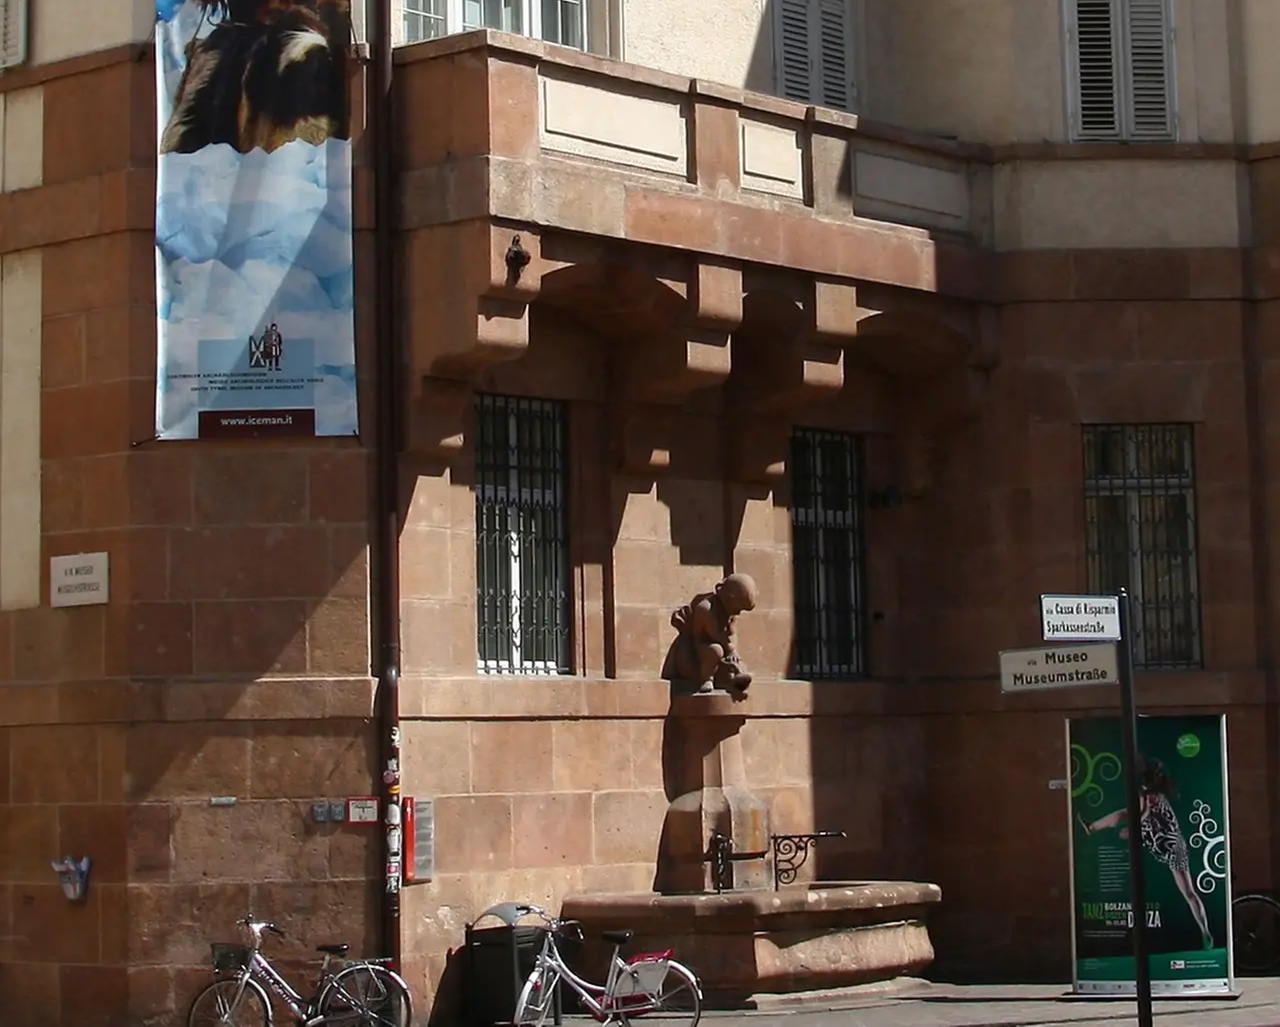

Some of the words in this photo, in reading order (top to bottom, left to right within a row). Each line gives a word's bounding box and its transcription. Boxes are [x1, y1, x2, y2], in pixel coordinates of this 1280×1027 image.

[220, 415, 293, 426] www.iceman.it
[1055, 602, 1074, 615] Cassa
[1076, 602, 1082, 615] di
[1084, 602, 1116, 617] Risparmio
[1045, 652, 1088, 665] Museo
[1013, 668, 1108, 686] Museumstraße
[1104, 902, 1132, 911] BOLZAN
